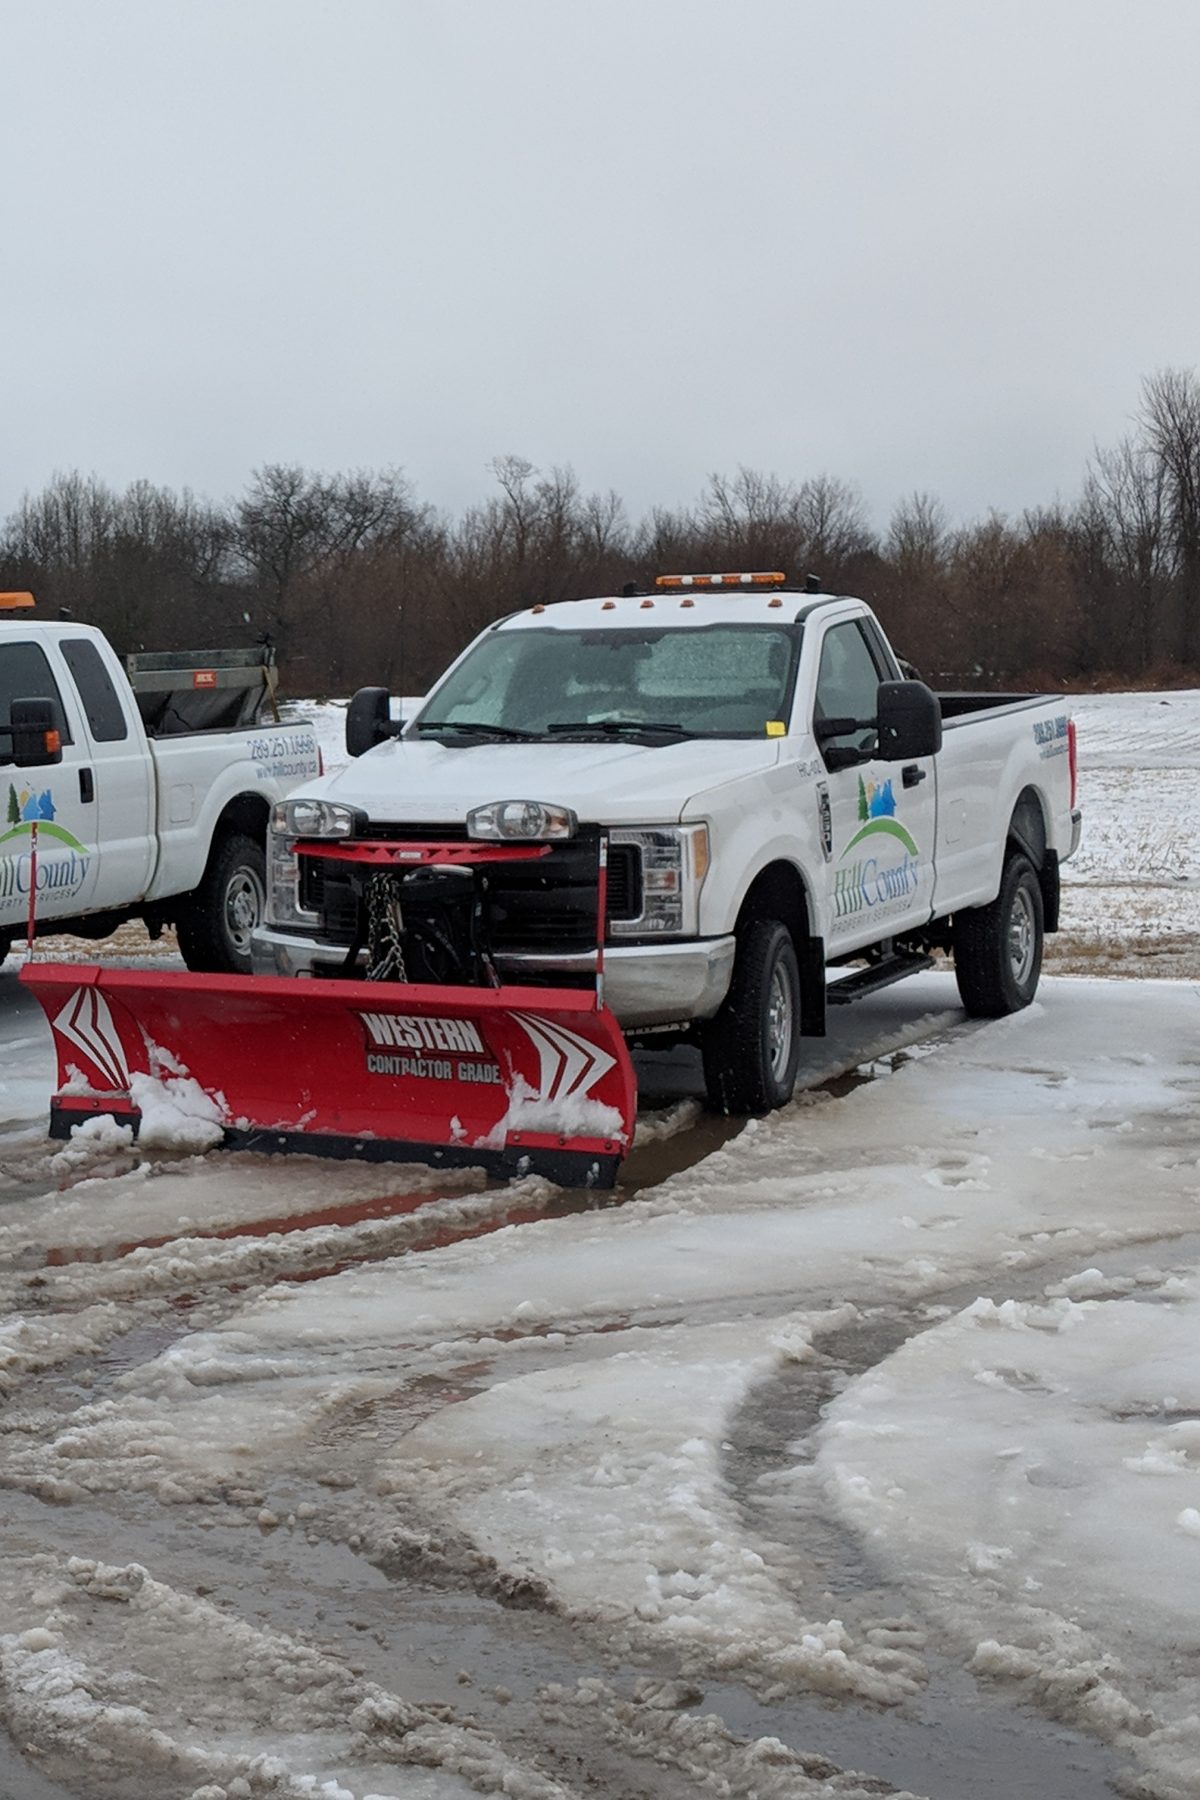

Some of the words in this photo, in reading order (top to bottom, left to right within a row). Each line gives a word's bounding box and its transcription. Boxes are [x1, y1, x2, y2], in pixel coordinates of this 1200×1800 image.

[359, 1012, 484, 1053] WESTERN
[367, 1054, 452, 1080] CONTRACTOR
[458, 1062, 503, 1084] GRADE
